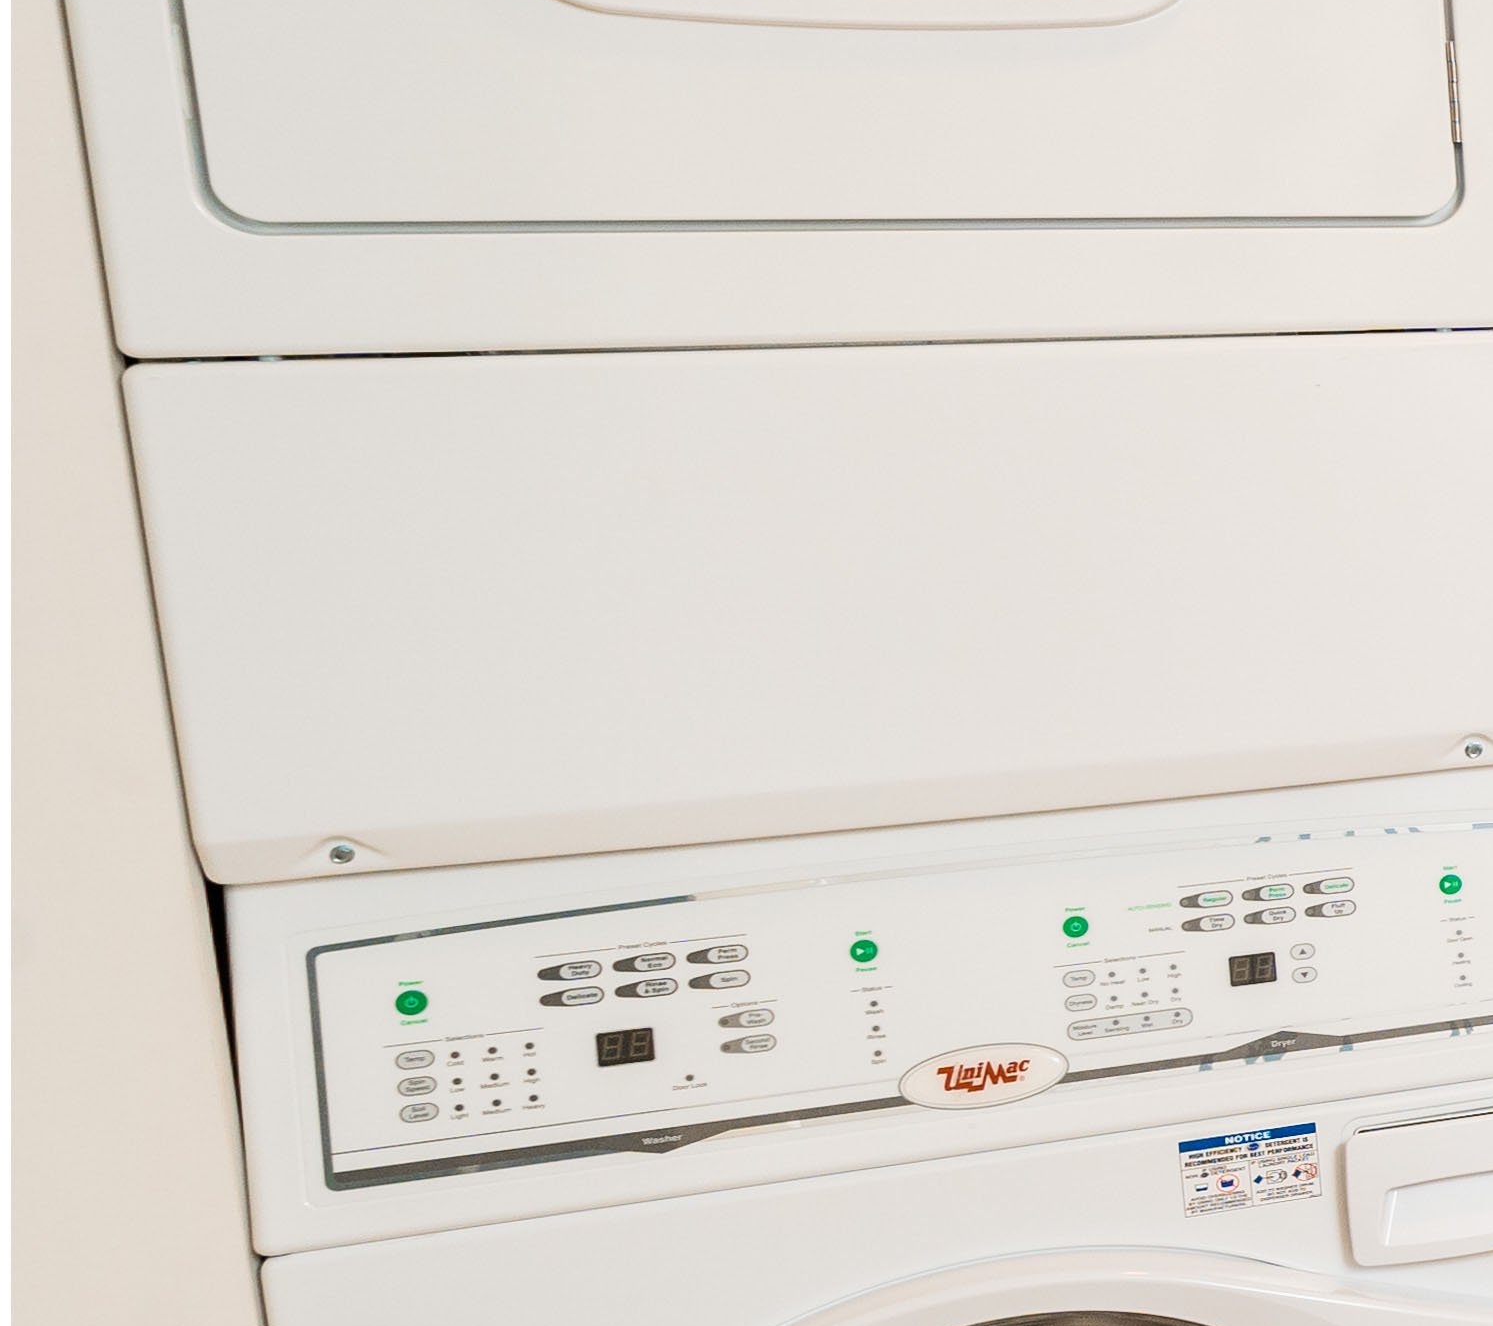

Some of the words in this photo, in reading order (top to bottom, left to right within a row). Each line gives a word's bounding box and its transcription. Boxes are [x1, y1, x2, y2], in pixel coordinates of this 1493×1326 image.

[1271, 1037, 1298, 1050] Dryer
[936, 1059, 1031, 1093] UniMac
[641, 1133, 683, 1146] Washer
[1224, 1130, 1272, 1145] NOTICE
